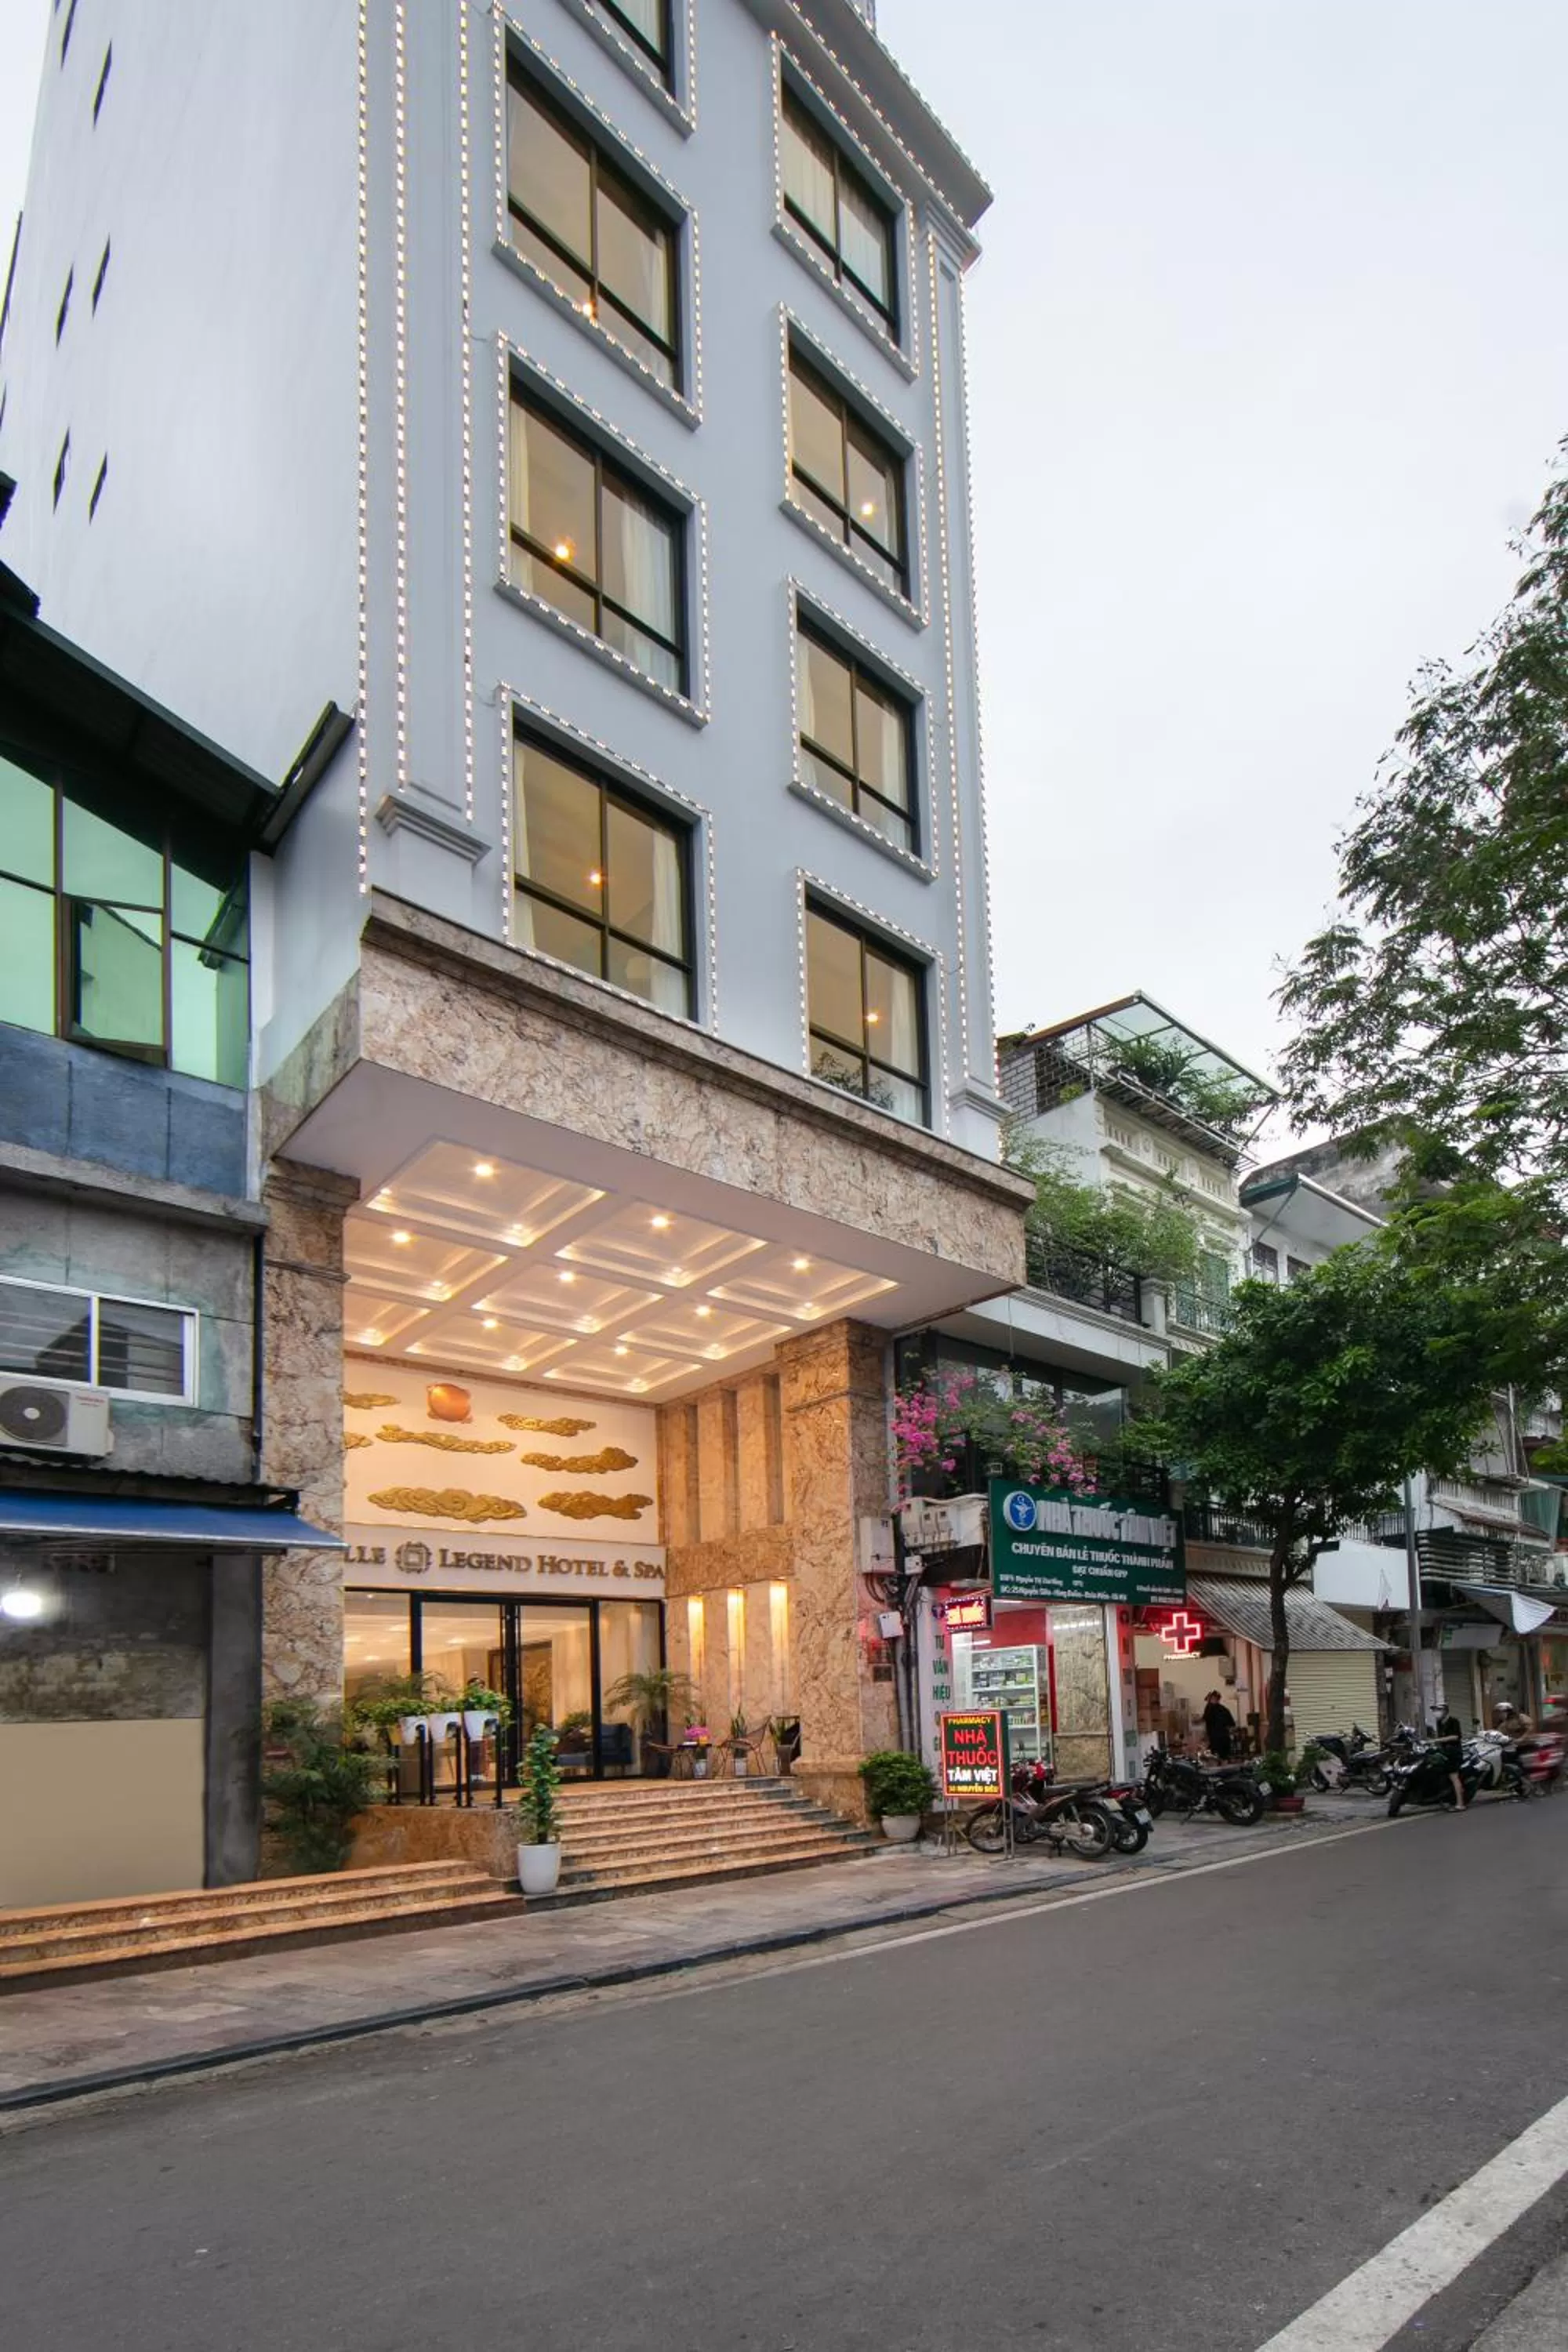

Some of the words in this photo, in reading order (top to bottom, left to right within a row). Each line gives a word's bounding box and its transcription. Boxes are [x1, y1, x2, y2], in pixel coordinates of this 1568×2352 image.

[1011, 1542, 1054, 1557] CHUYÊN
[1055, 1544, 1076, 1559] BÁN
[612, 1559, 631, 1578] &
[947, 1746, 997, 1766] THUỐC
[947, 1766, 971, 1782] TÂM
[973, 1766, 997, 1785] VIỆT
